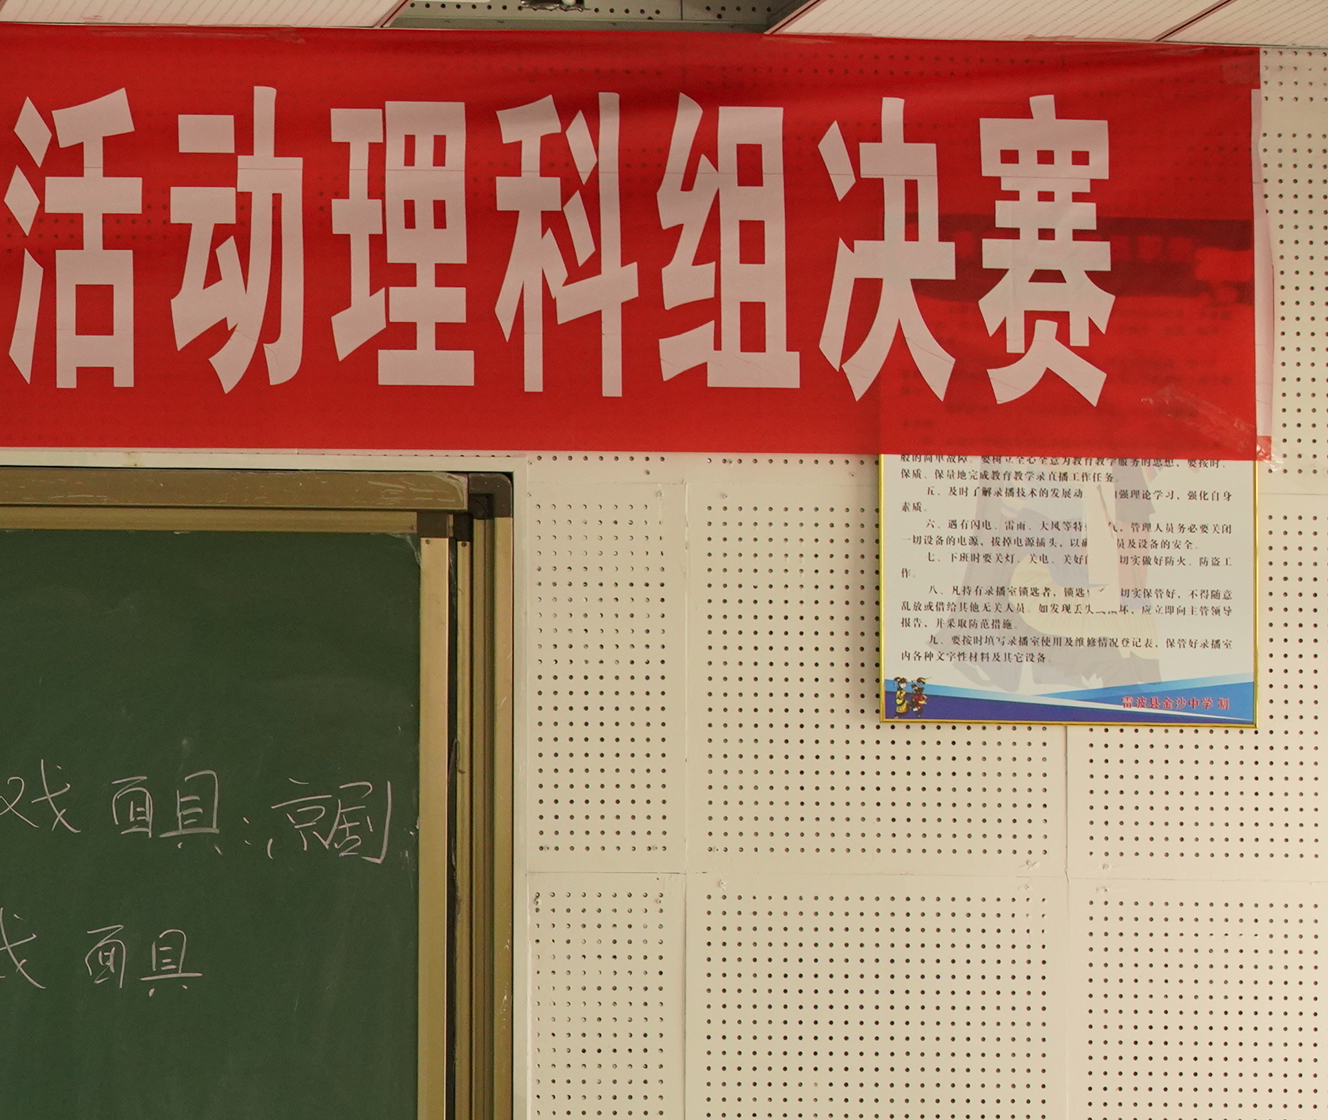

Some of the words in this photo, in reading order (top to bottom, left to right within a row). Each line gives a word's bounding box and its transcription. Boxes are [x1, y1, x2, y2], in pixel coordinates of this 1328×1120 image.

[1121, 695, 1213, 710] 雷波县金沙中学
